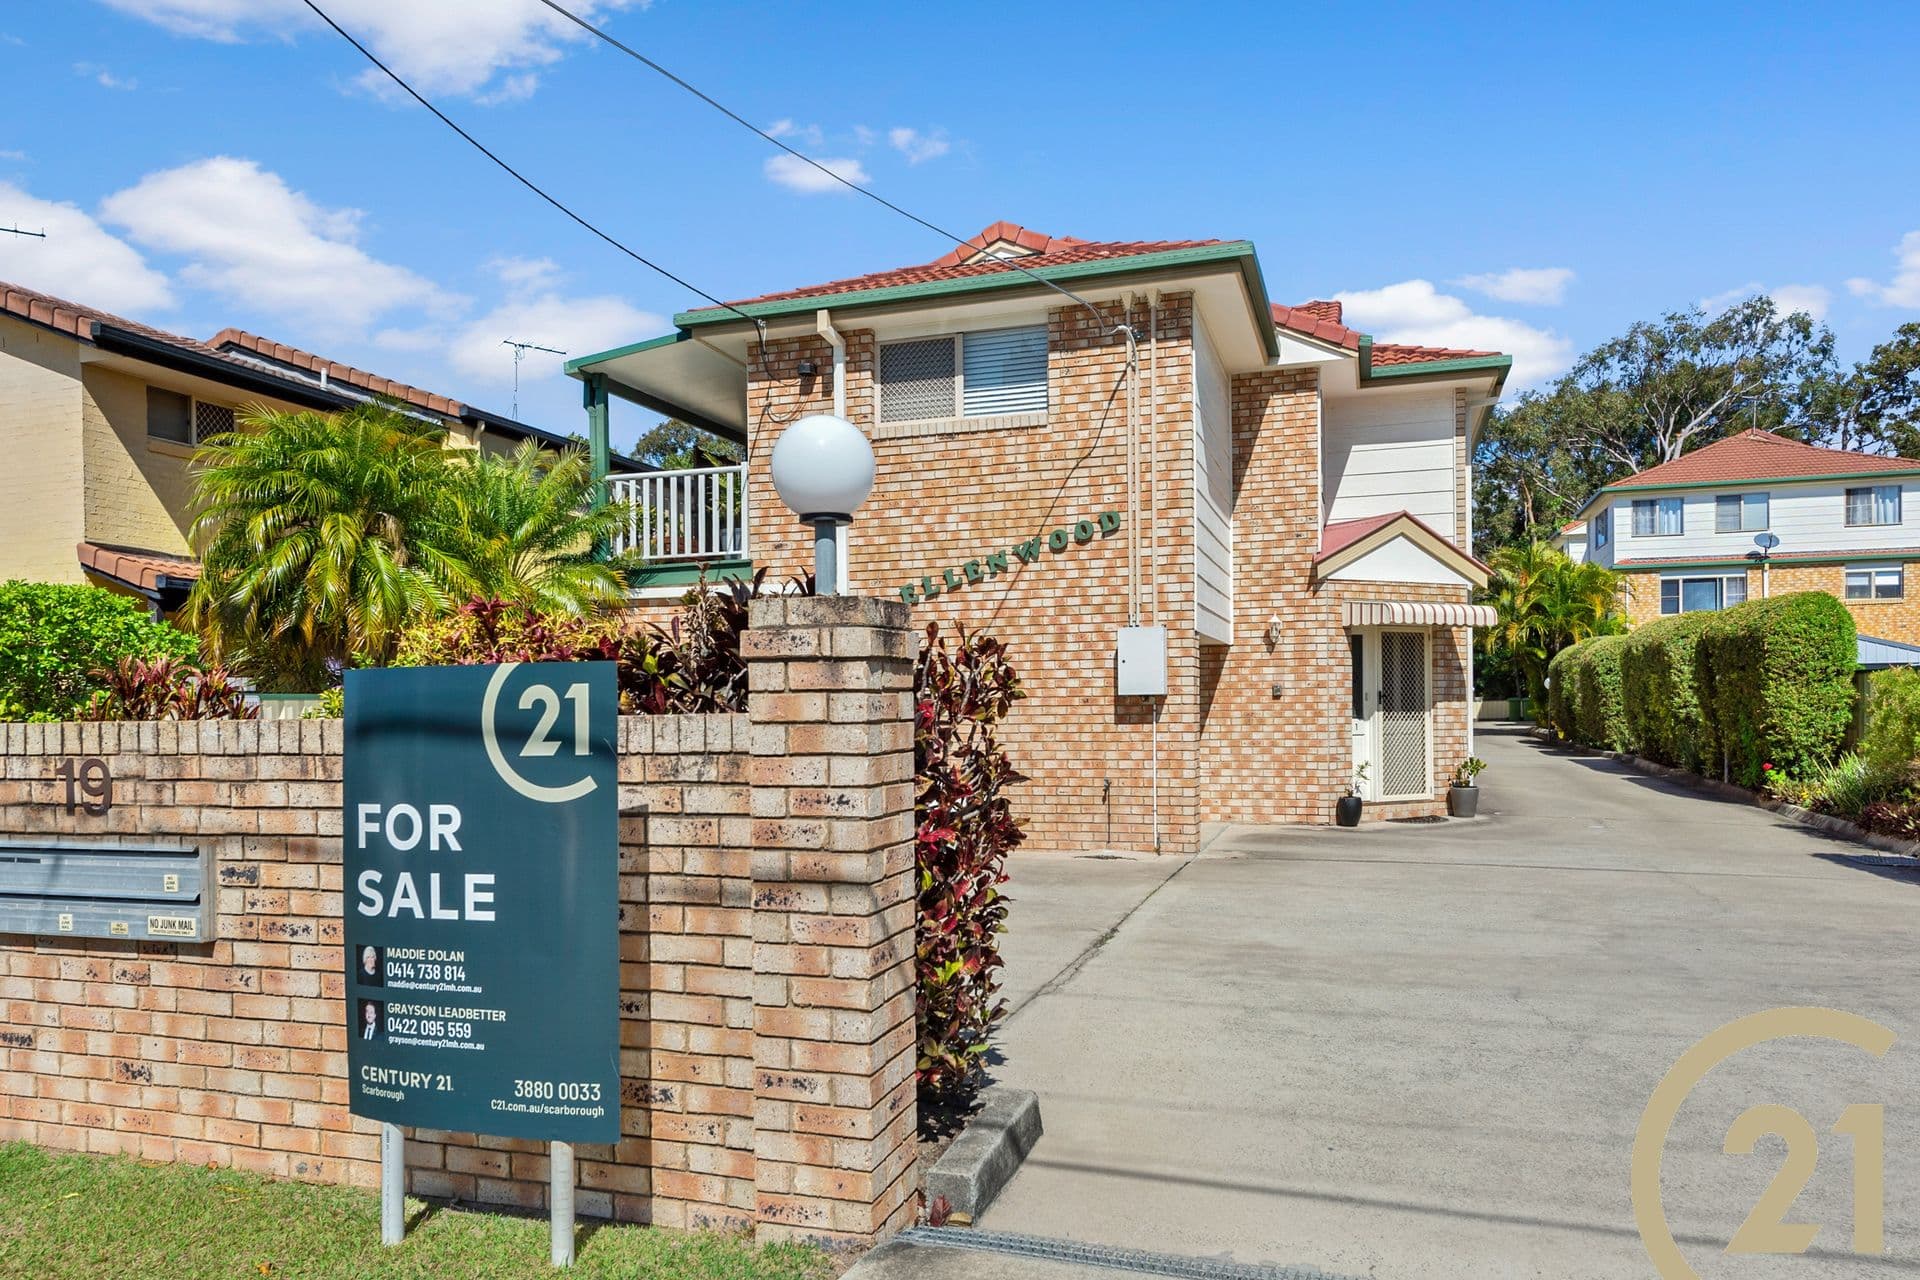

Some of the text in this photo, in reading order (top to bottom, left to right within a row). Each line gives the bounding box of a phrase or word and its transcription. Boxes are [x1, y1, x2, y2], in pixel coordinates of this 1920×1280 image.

[899, 511, 1121, 605] ELLENWOOD
[518, 682, 591, 757] 21
[55, 757, 113, 817] 19
[357, 803, 463, 851] FOR
[357, 869, 496, 921] SALE
[150, 919, 194, 931] NO JUNK MAIL
[386, 947, 465, 962] MADDIE DOLAN
[386, 962, 466, 982] 0414 738 814
[387, 980, 483, 993] maddie@century21mh.com.au
[387, 1003, 507, 1022] GRAYSON LEADBETTER
[387, 1017, 472, 1039] 0422 095 559
[388, 1035, 485, 1050] grayson@century21mh.com.au
[361, 1065, 433, 1090] CENTURY
[361, 1083, 405, 1103] Scarborough
[513, 1079, 602, 1101] 3880 0033
[490, 1099, 605, 1119] C21.com.au/scarborough
